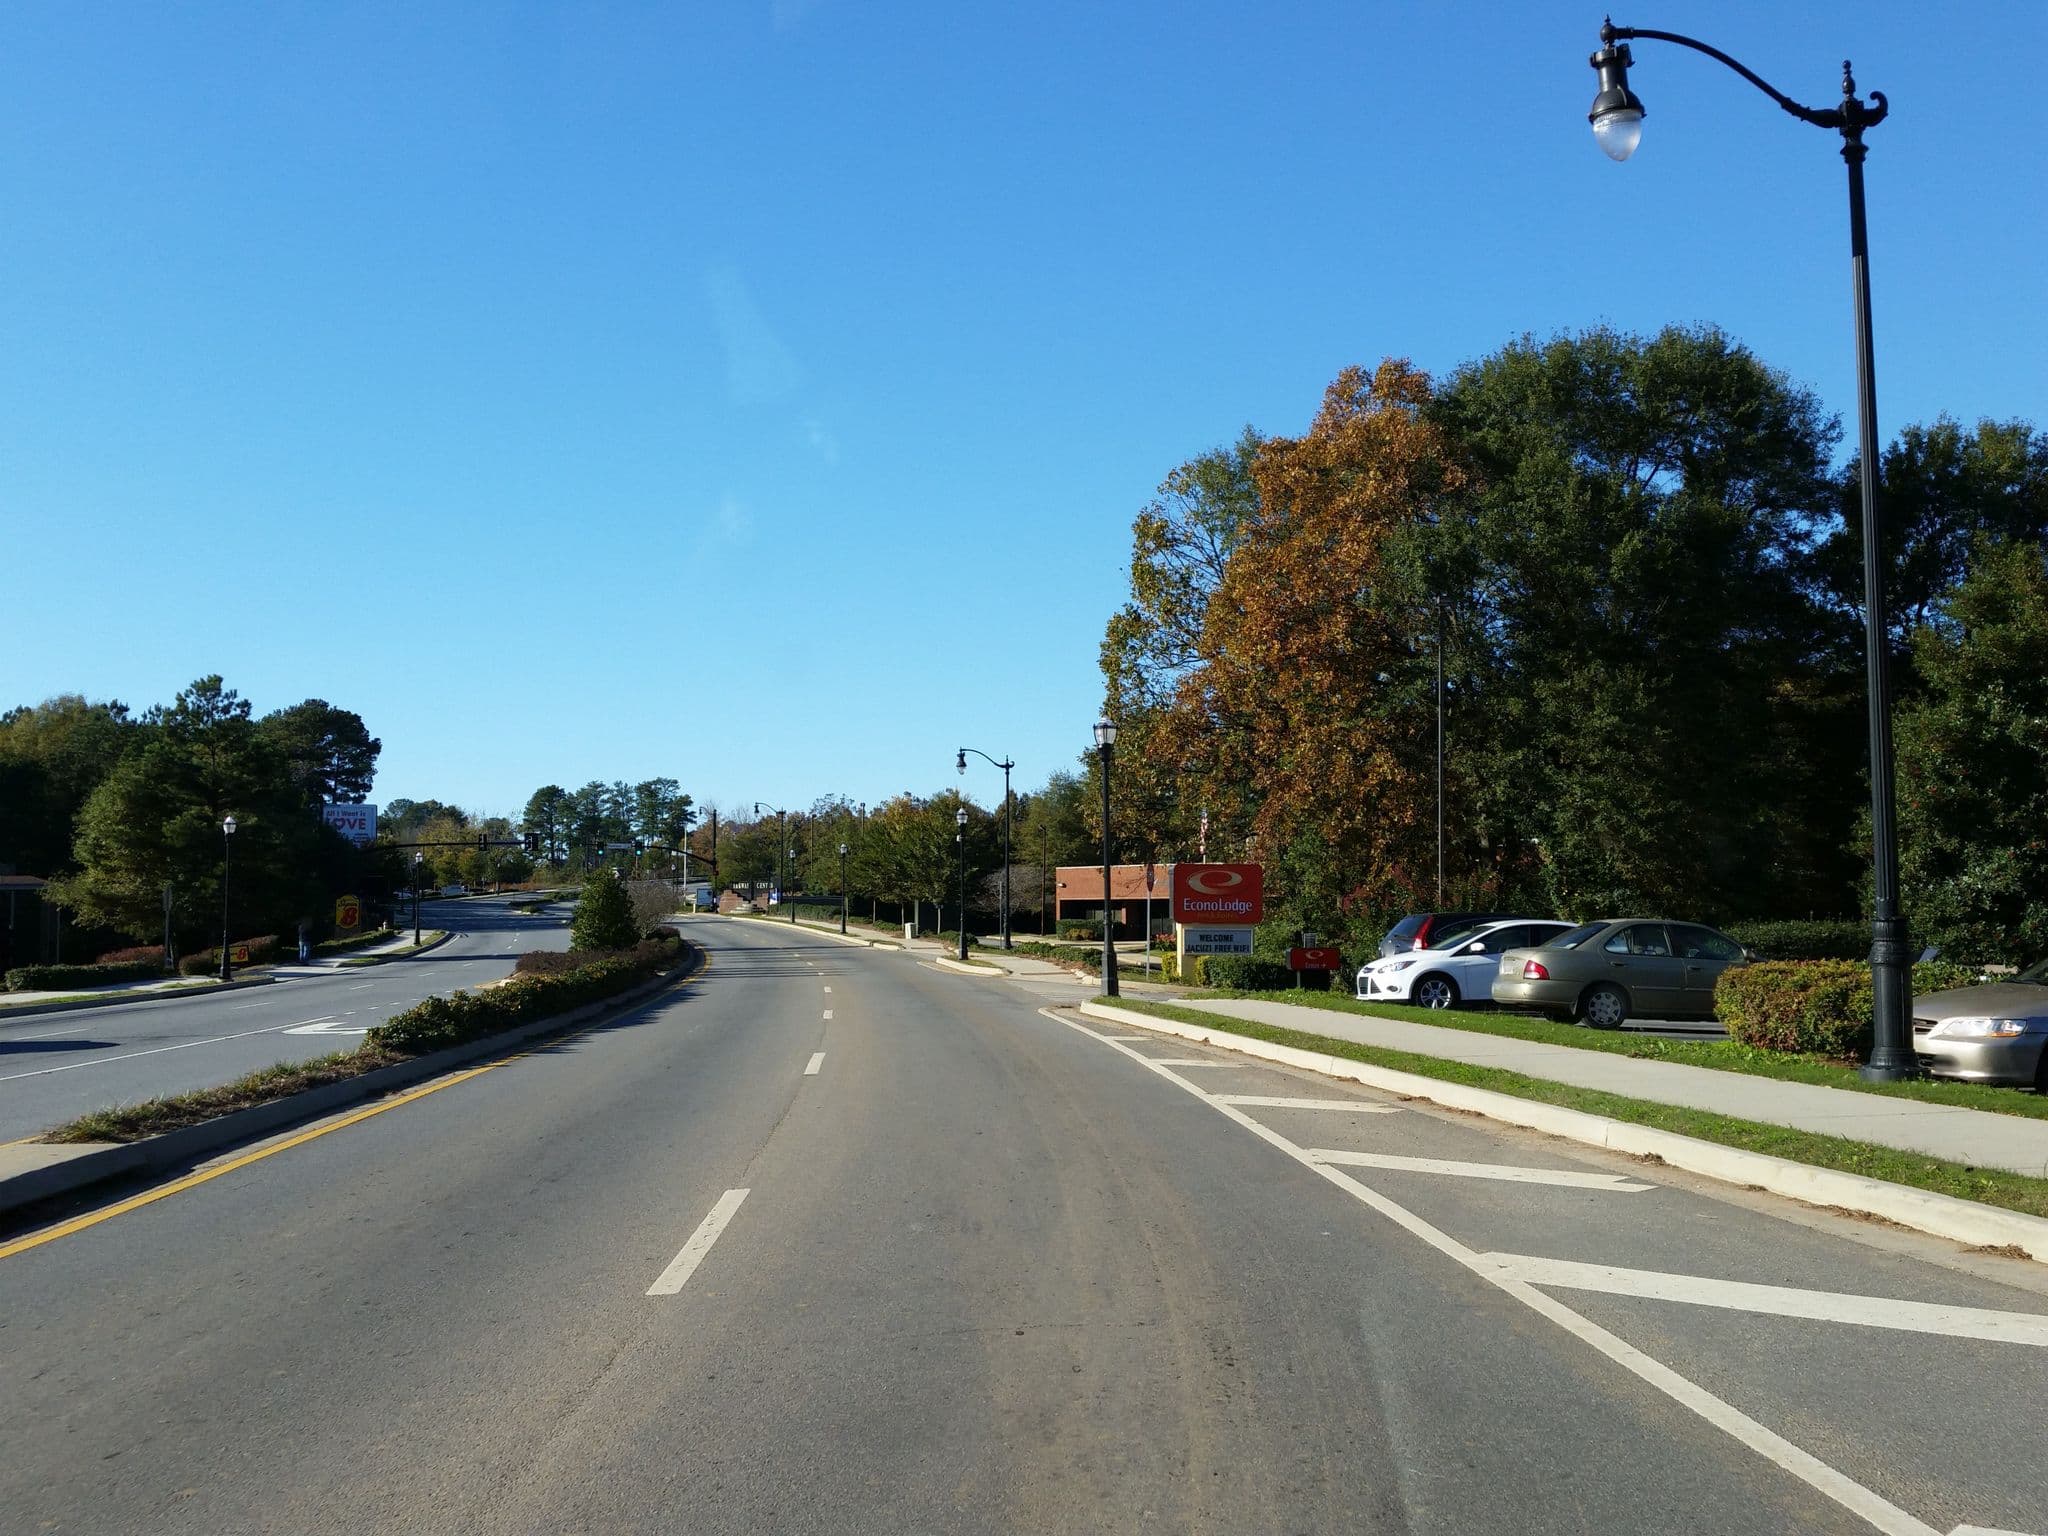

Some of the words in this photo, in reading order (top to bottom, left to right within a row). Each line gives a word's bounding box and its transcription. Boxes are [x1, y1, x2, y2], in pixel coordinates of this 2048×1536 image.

[1183, 898, 1253, 914] EconoLodge
[1199, 934, 1234, 943] WELCOME
[1214, 944, 1232, 953] FREE
